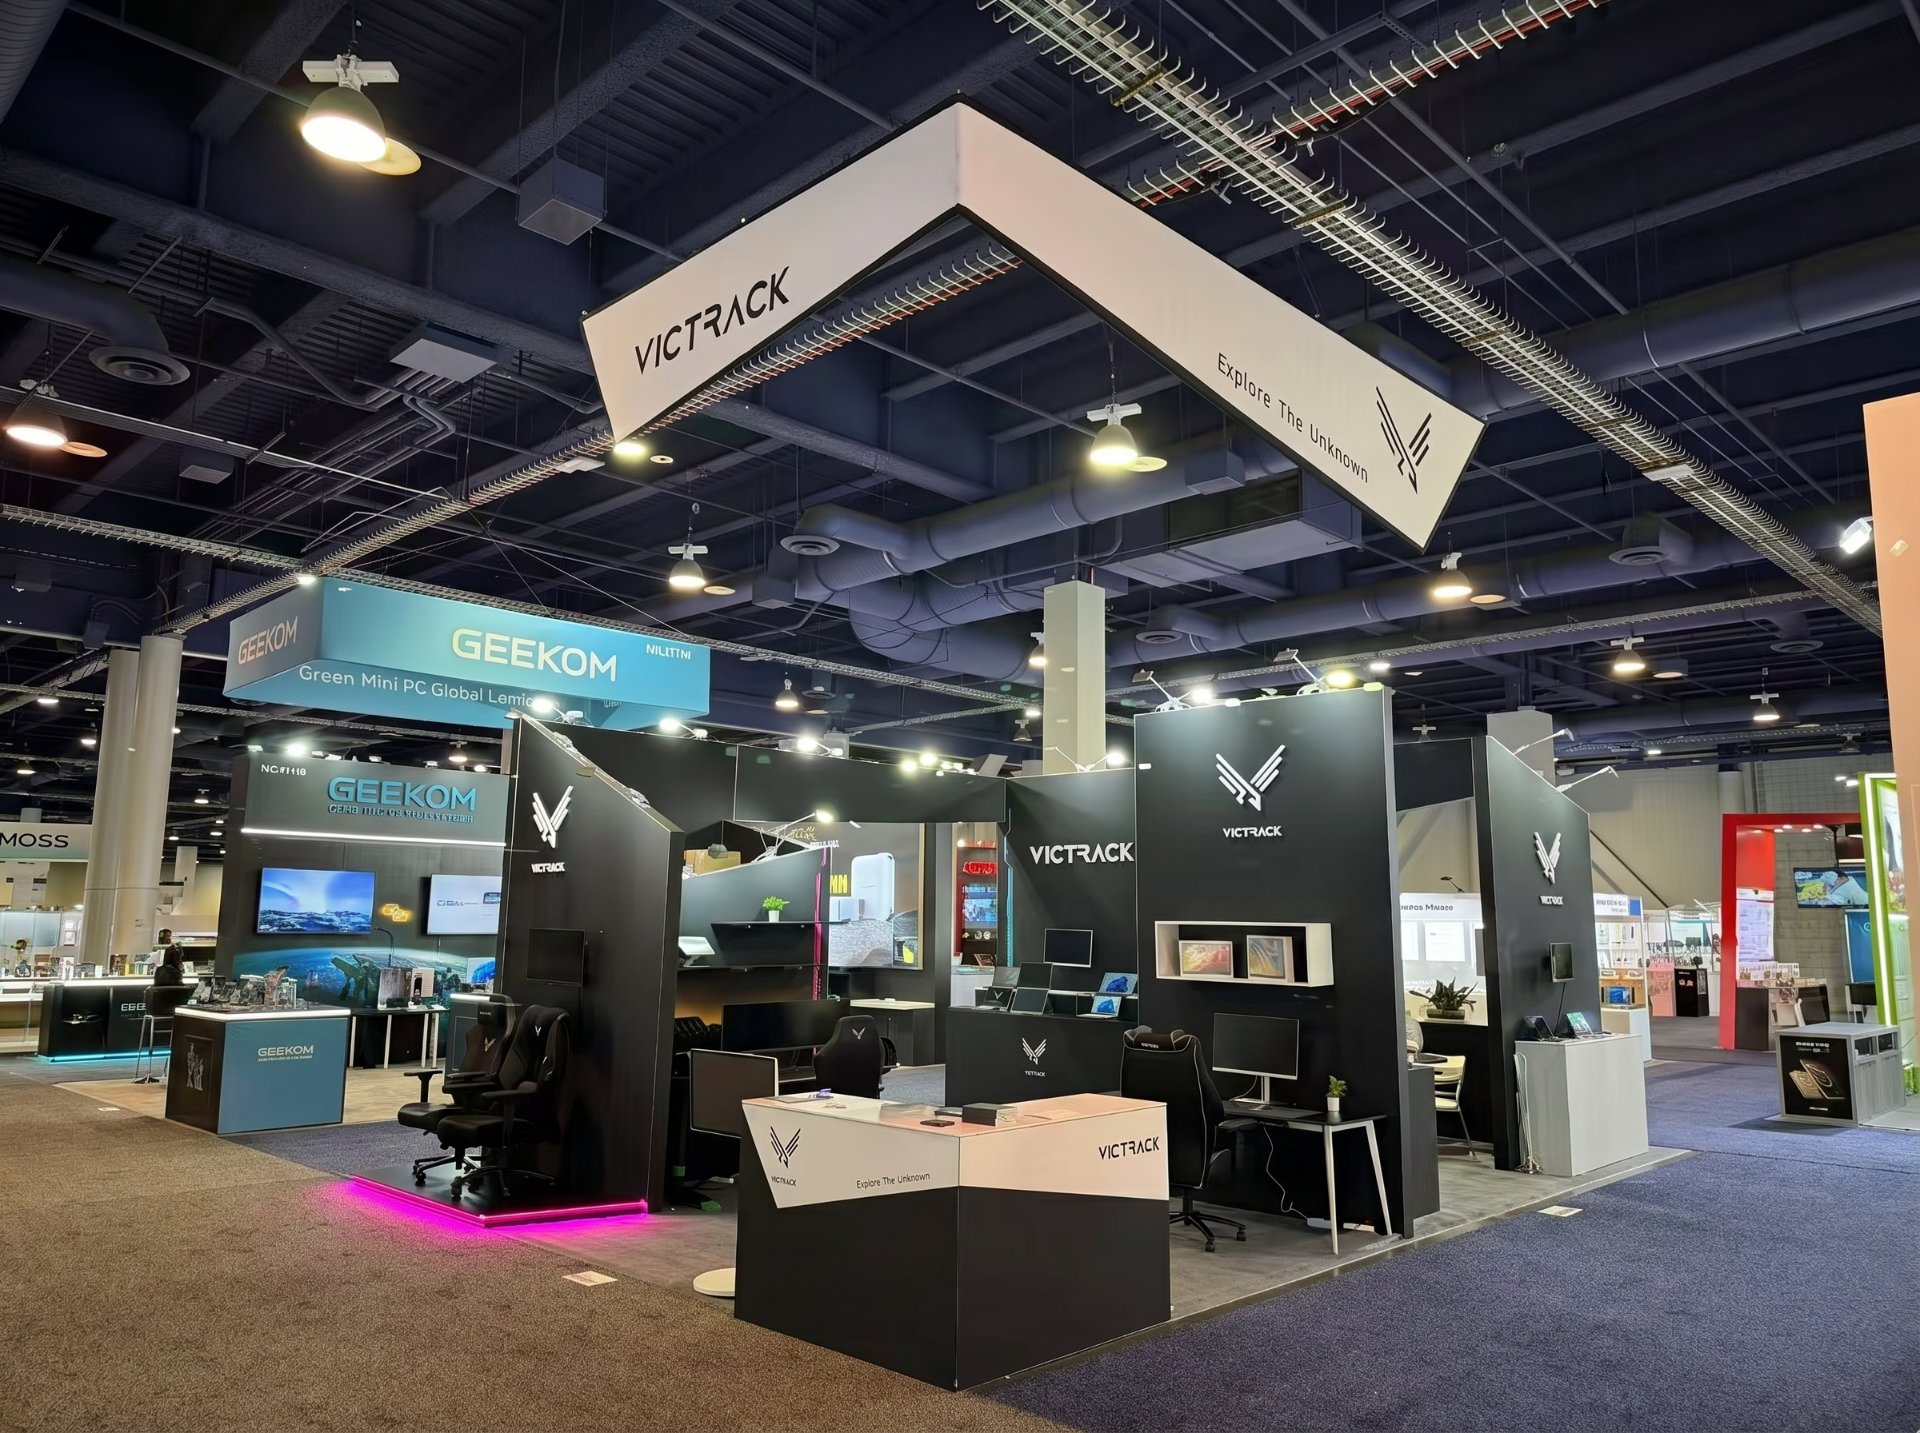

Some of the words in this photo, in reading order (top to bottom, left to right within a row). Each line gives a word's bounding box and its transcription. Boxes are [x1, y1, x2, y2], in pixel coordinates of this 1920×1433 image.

[634, 265, 790, 375] VICTRACK
[1217, 352, 1271, 408] Explore
[1278, 399, 1303, 433] The
[1310, 423, 1368, 483] Unknown
[238, 616, 298, 665] GEEKOM
[452, 628, 617, 682] GEEKOM
[299, 665, 355, 686] Green
[362, 672, 398, 691] Mini
[403, 678, 427, 695] PC
[431, 682, 483, 702] Global
[328, 776, 477, 811] GEEKOM
[0, 832, 69, 848] MOSS
[1222, 825, 1282, 838] VICTRACK
[1029, 842, 1135, 865] VICTRACK
[257, 1044, 314, 1057] GEEKOM
[1098, 1136, 1160, 1160] VICTRACK
[856, 1179, 881, 1190] Explore
[882, 1176, 896, 1185] The
[897, 1172, 931, 1184] Unknown
